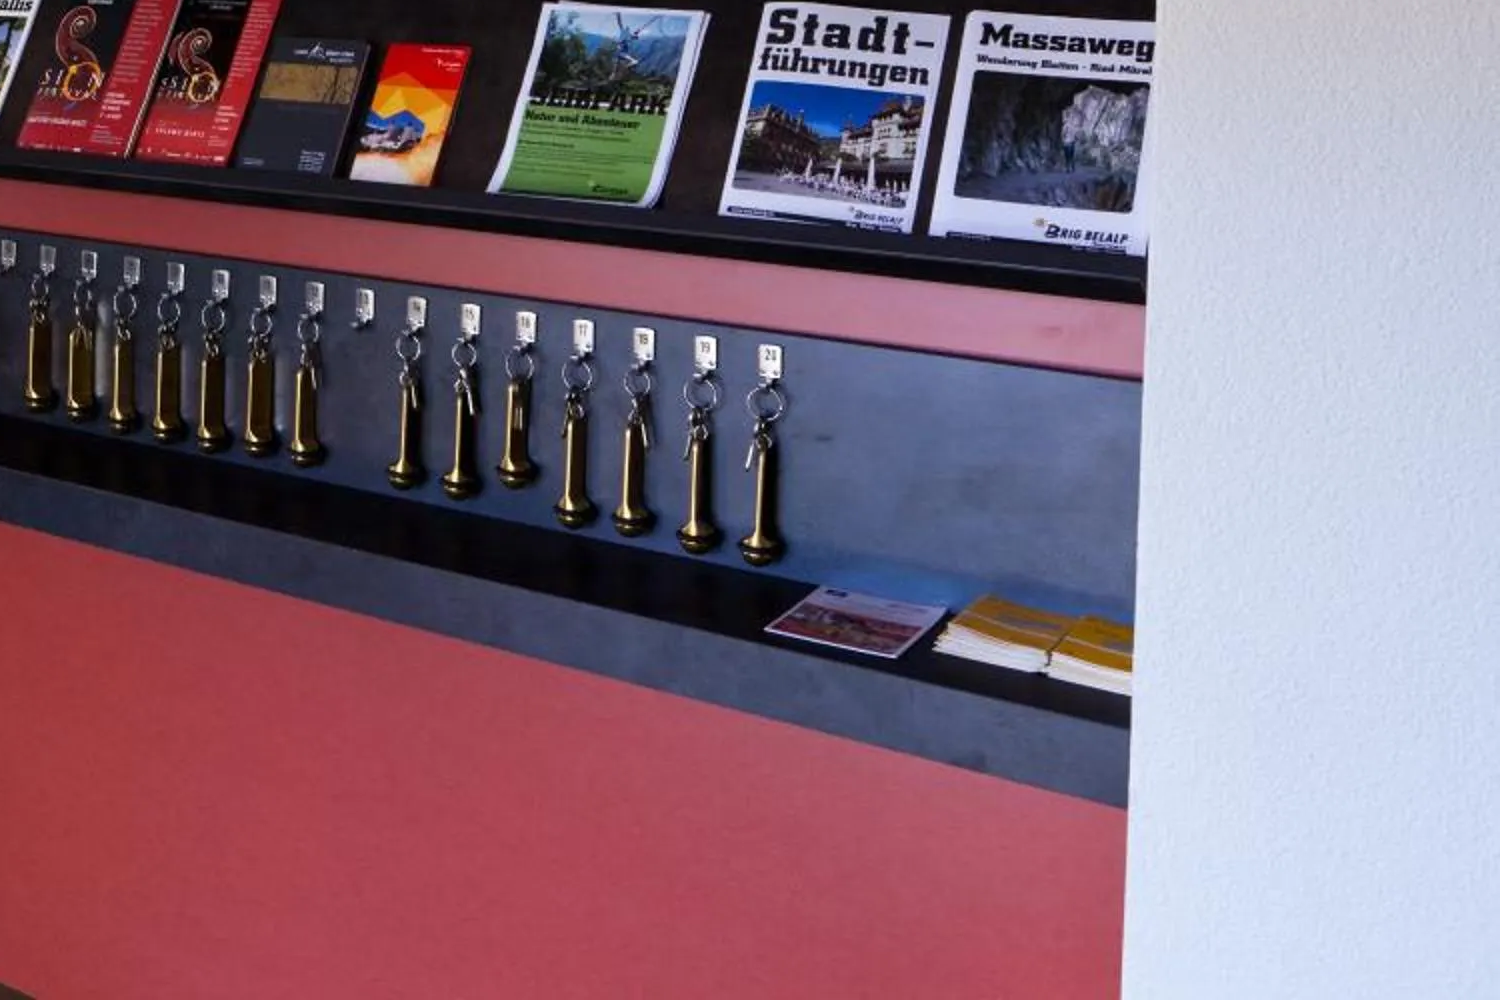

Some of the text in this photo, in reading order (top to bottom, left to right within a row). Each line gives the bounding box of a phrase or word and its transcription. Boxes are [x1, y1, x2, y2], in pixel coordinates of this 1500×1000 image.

[766, 8, 935, 55] Stadt-
[980, 22, 1156, 63] Massaweg
[758, 47, 930, 87] führungen
[1045, 223, 1129, 244] BRIG BELALP
